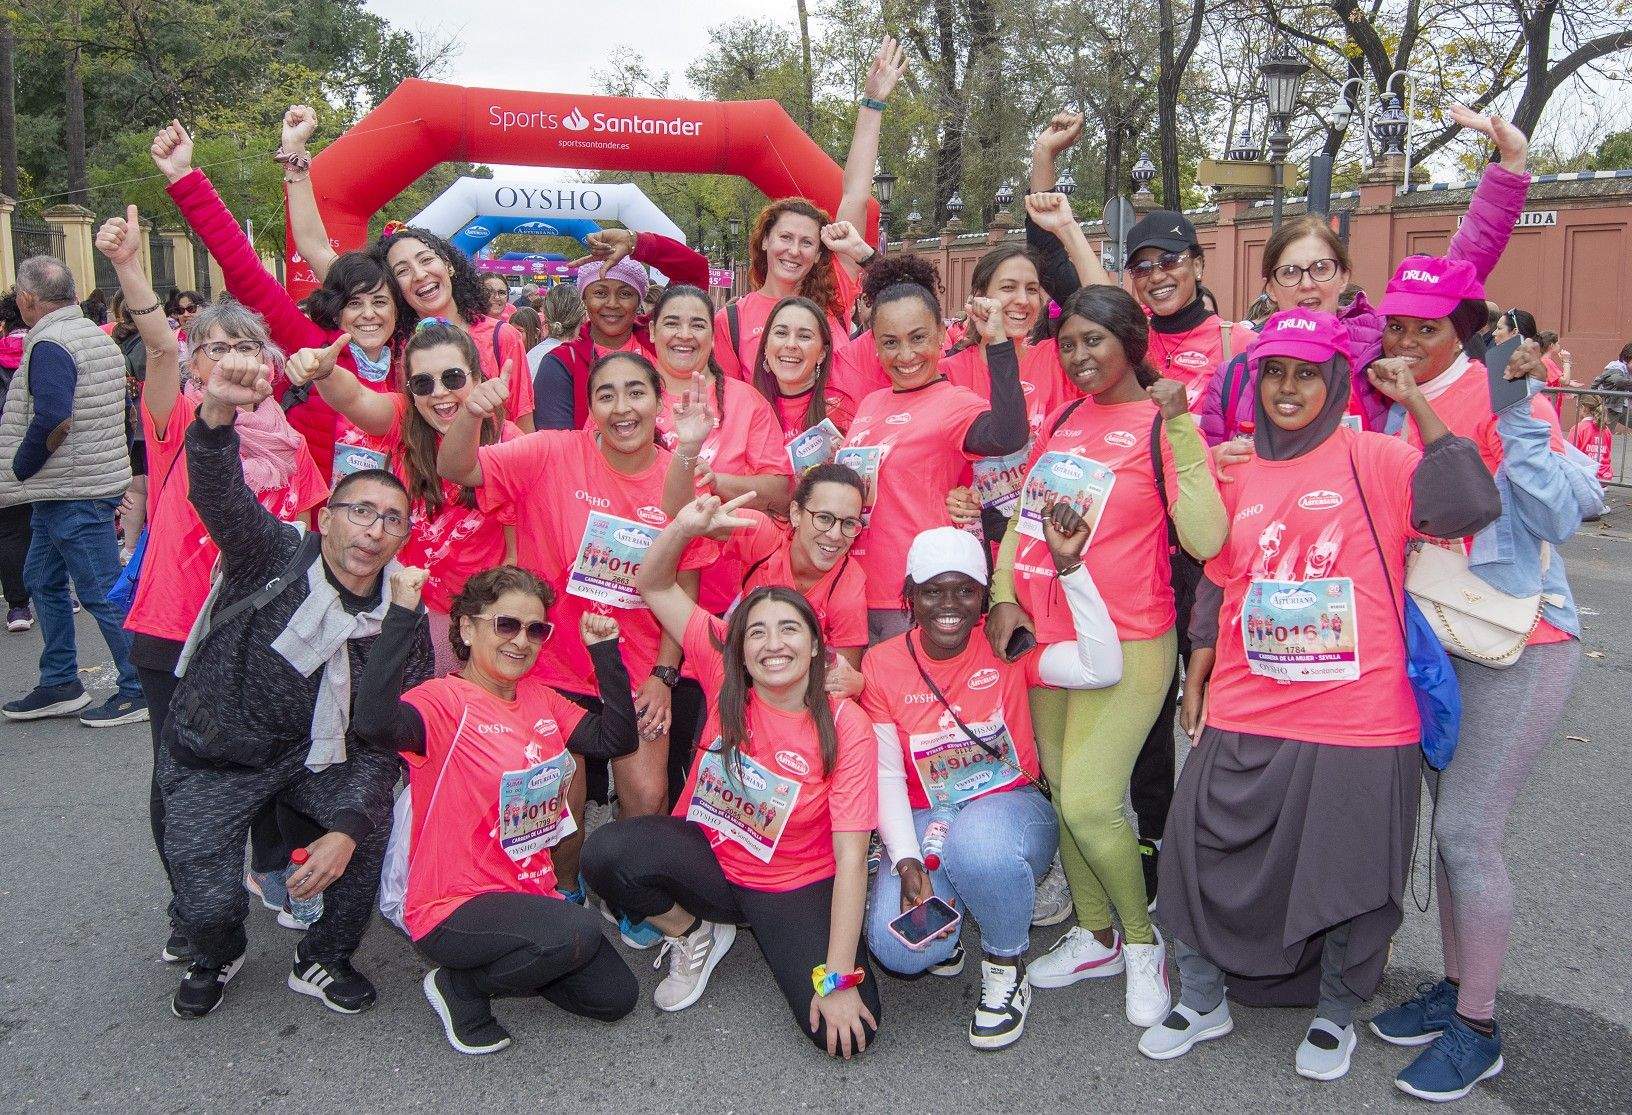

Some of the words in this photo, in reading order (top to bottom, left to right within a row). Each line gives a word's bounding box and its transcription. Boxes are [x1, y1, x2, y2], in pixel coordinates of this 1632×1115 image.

[489, 105, 558, 131] Sports
[593, 112, 703, 136] Santander
[558, 138, 630, 150] sportssantander.es
[494, 186, 602, 212] OYSHO
[1402, 270, 1439, 284] DRUNI
[1277, 318, 1316, 332] DRUNI
[1275, 625, 1318, 642] 016
[1285, 646, 1306, 654] 1784
[904, 693, 940, 705] OYSH
[528, 798, 558, 820] 016
[722, 789, 755, 816] 016
